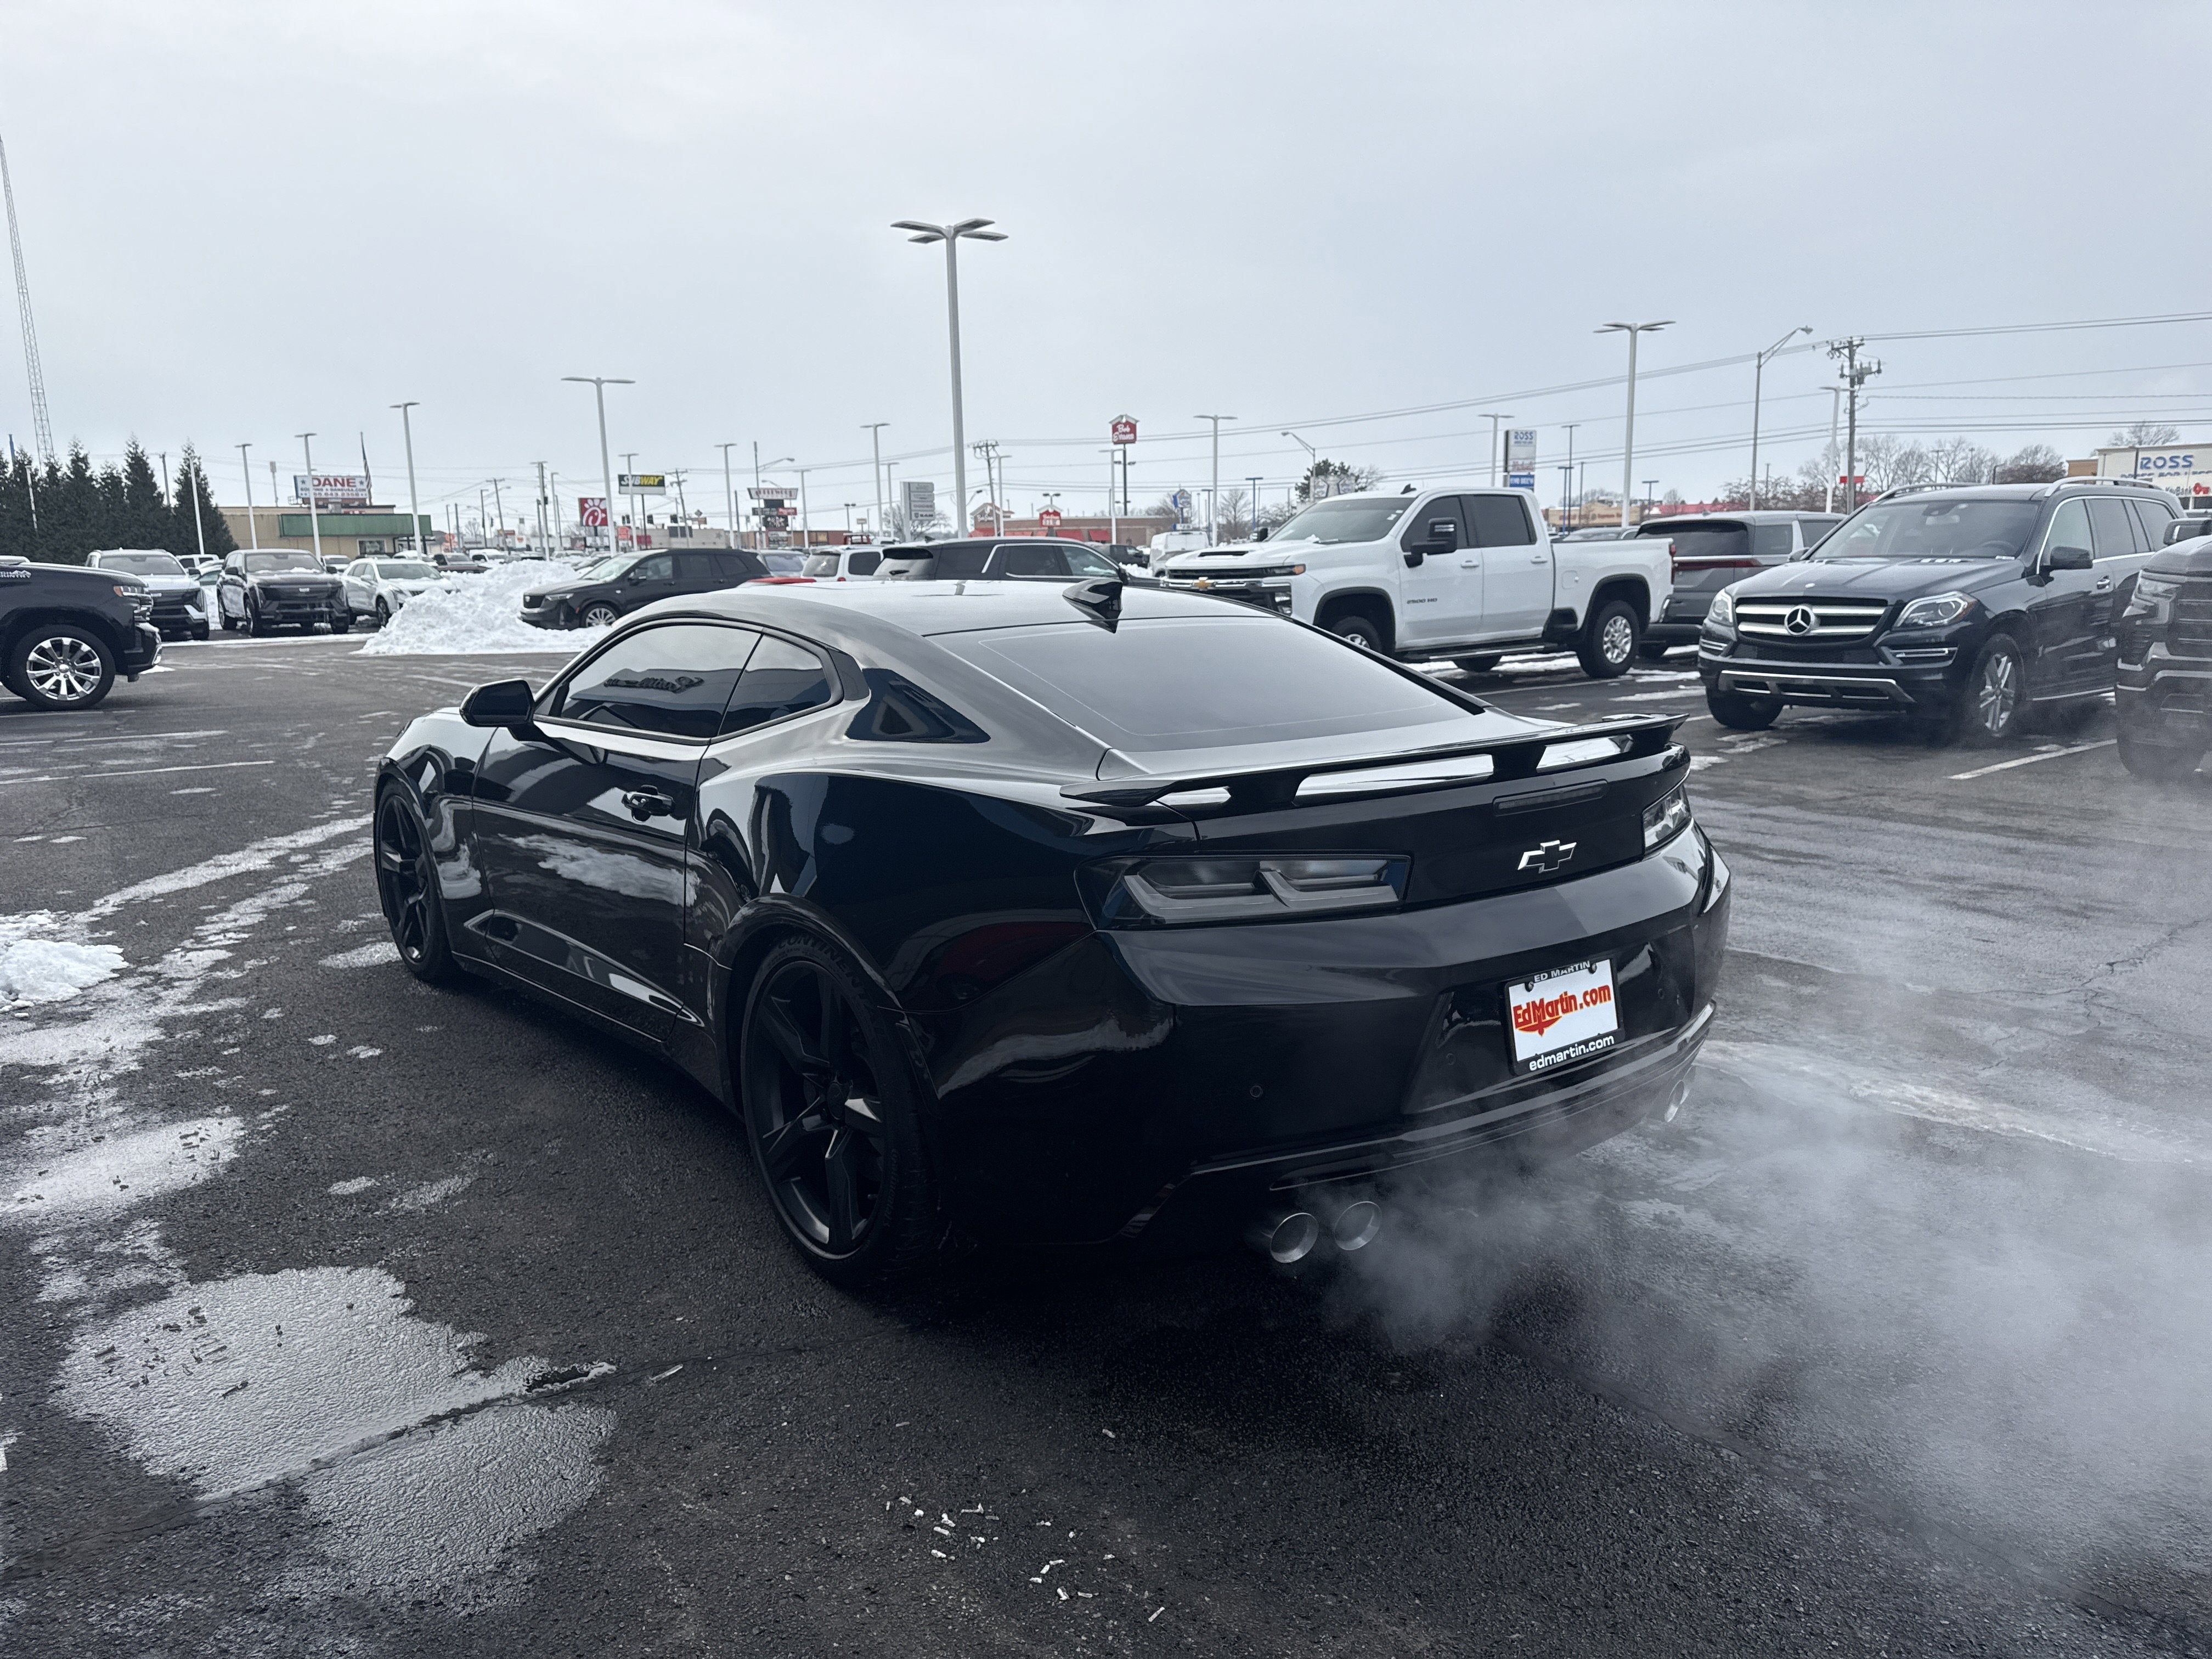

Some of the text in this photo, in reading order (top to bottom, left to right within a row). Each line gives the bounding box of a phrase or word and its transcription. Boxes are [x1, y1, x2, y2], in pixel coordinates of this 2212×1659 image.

[1116, 424, 1130, 433] Bob
[1514, 431, 1533, 440] ROSS
[2140, 455, 2193, 470] ROSS
[312, 477, 357, 487] DANE
[1534, 961, 1591, 983] ED MARTIN
[1513, 984, 1612, 1031] EdMartin.com
[1529, 1035, 1615, 1071] edmartin.com
